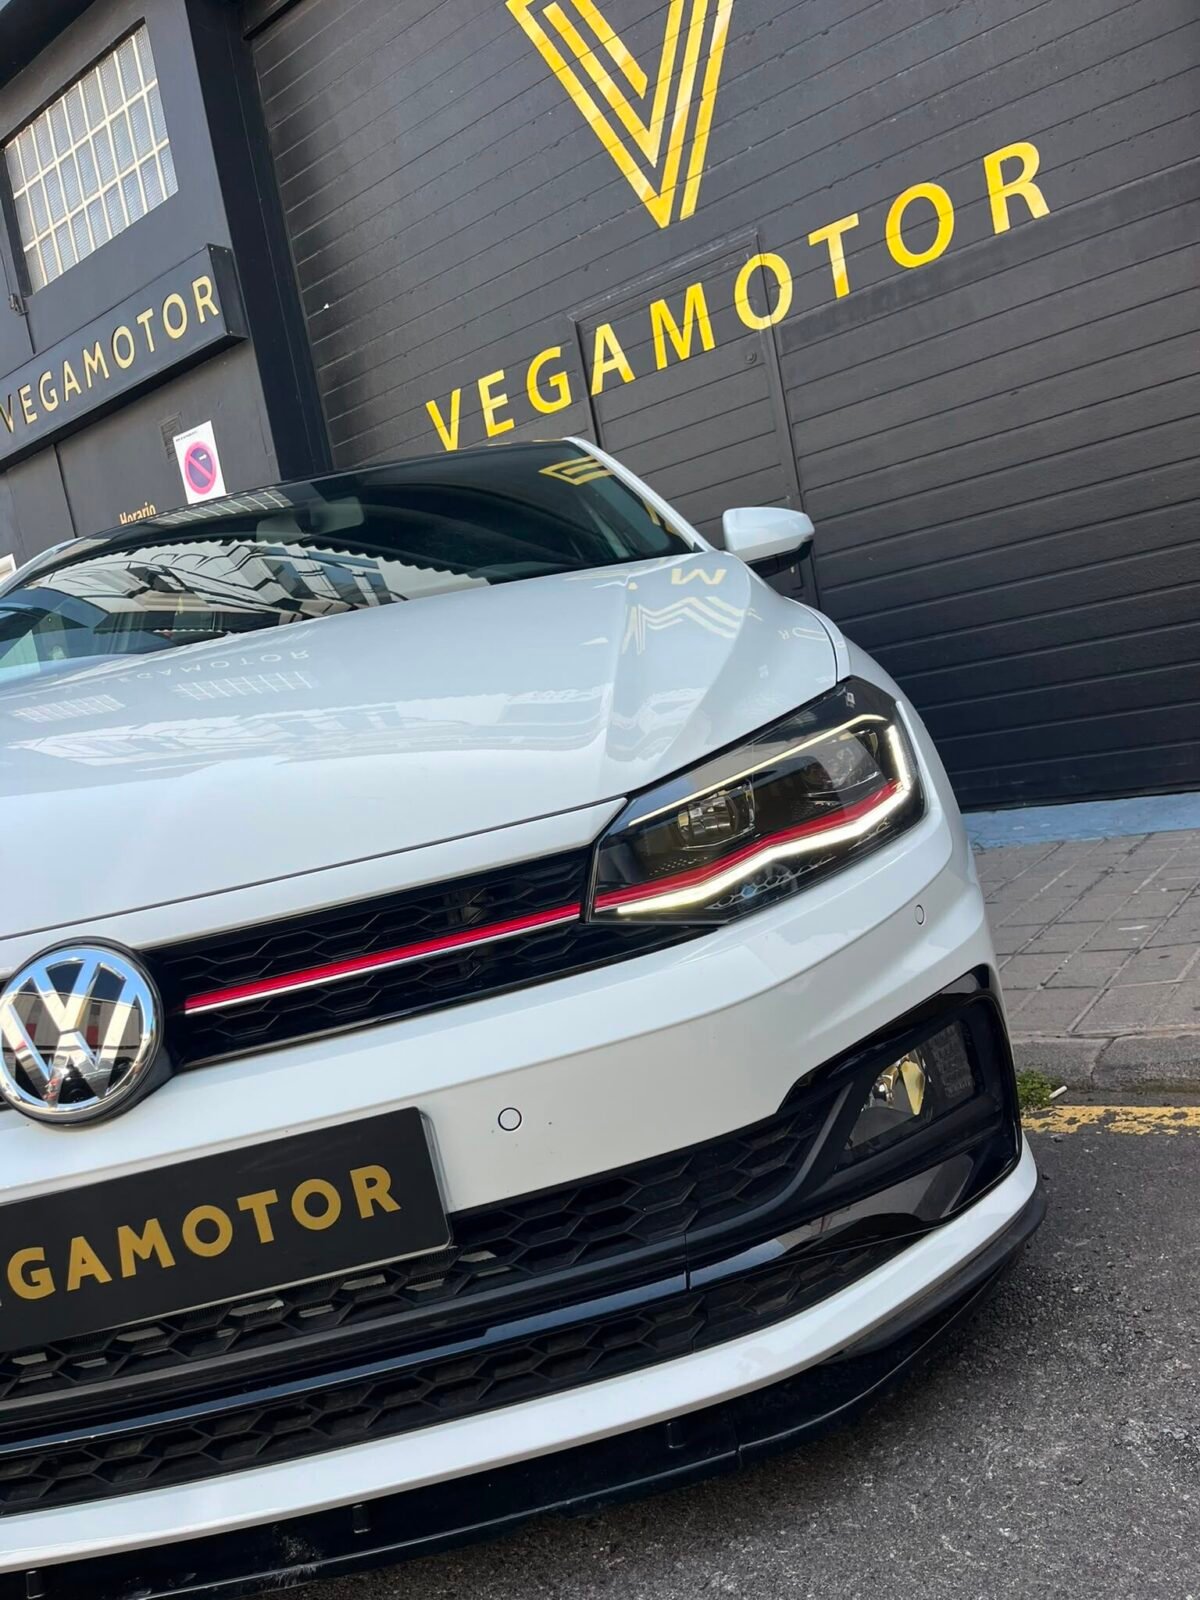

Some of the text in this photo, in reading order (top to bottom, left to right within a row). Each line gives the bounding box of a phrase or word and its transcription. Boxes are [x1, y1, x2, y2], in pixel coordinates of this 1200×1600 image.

[0, 274, 220, 433] VEGAMOTOR
[426, 141, 1050, 450] VEGAMOTOR
[0, 1164, 402, 1308] GAMOTOR
